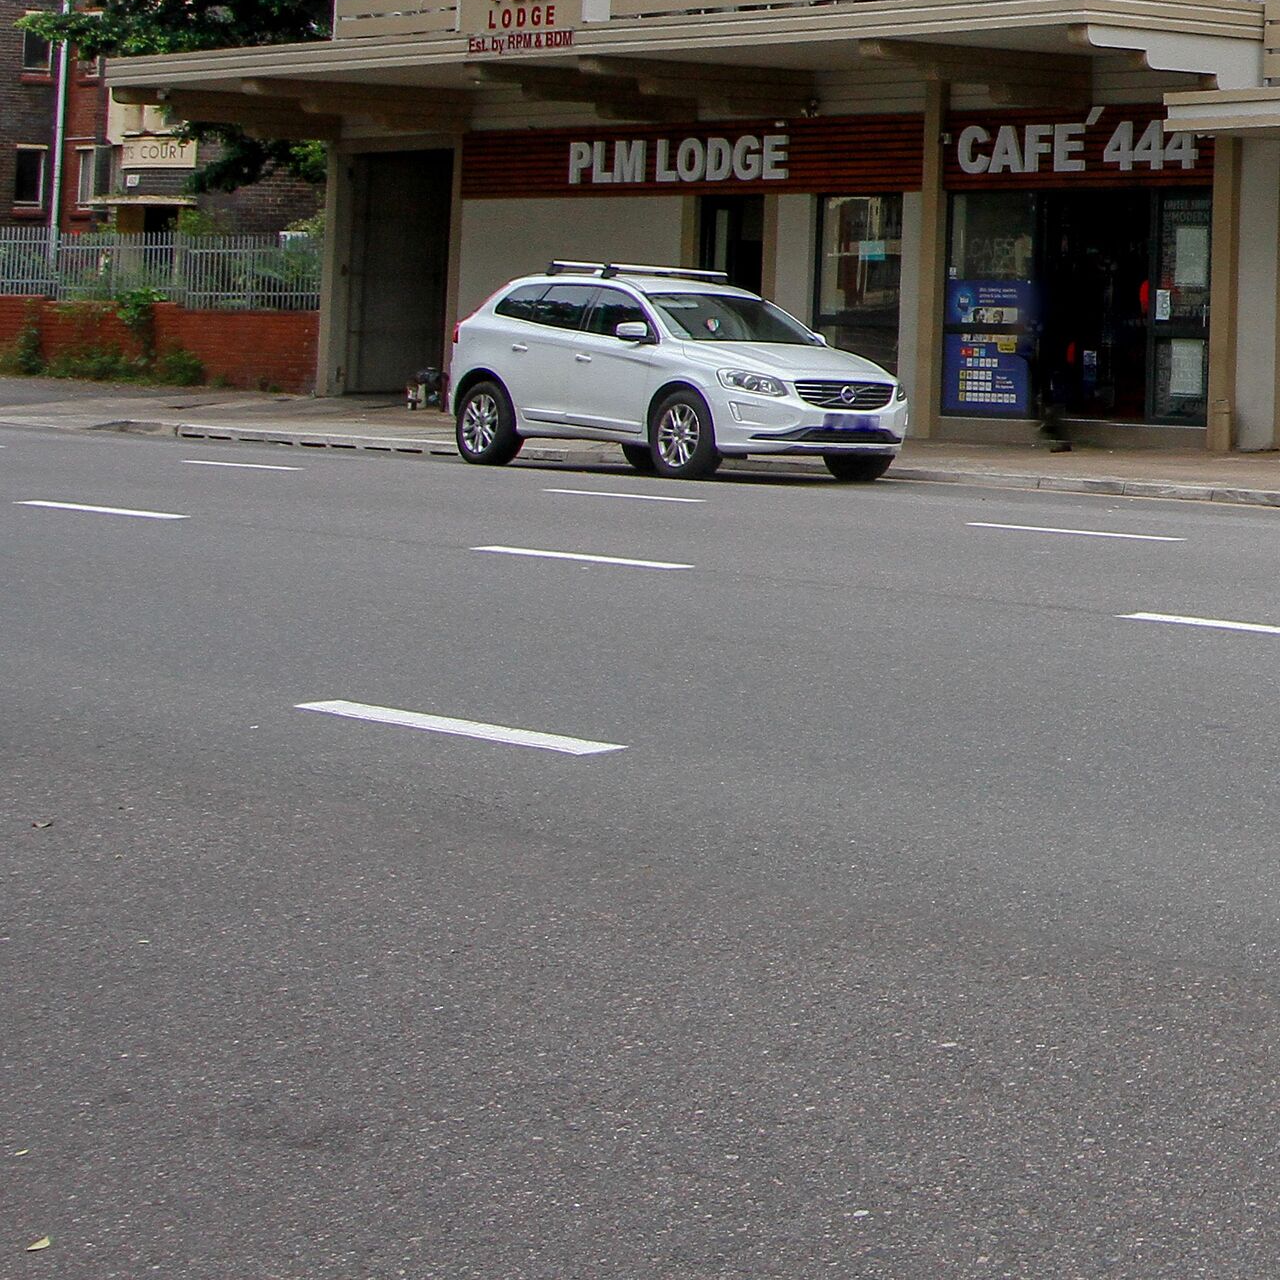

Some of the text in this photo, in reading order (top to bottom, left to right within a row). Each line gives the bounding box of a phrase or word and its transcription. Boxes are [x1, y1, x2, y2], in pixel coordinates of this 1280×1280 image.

[488, 5, 556, 29] LODGE
[492, 36, 505, 55] by
[508, 33, 532, 49] RPM
[535, 33, 543, 48] &
[546, 31, 573, 47] BDM
[140, 145, 186, 159] COURT
[1103, 120, 1199, 171] 444
[569, 135, 791, 185] PLM LODGE
